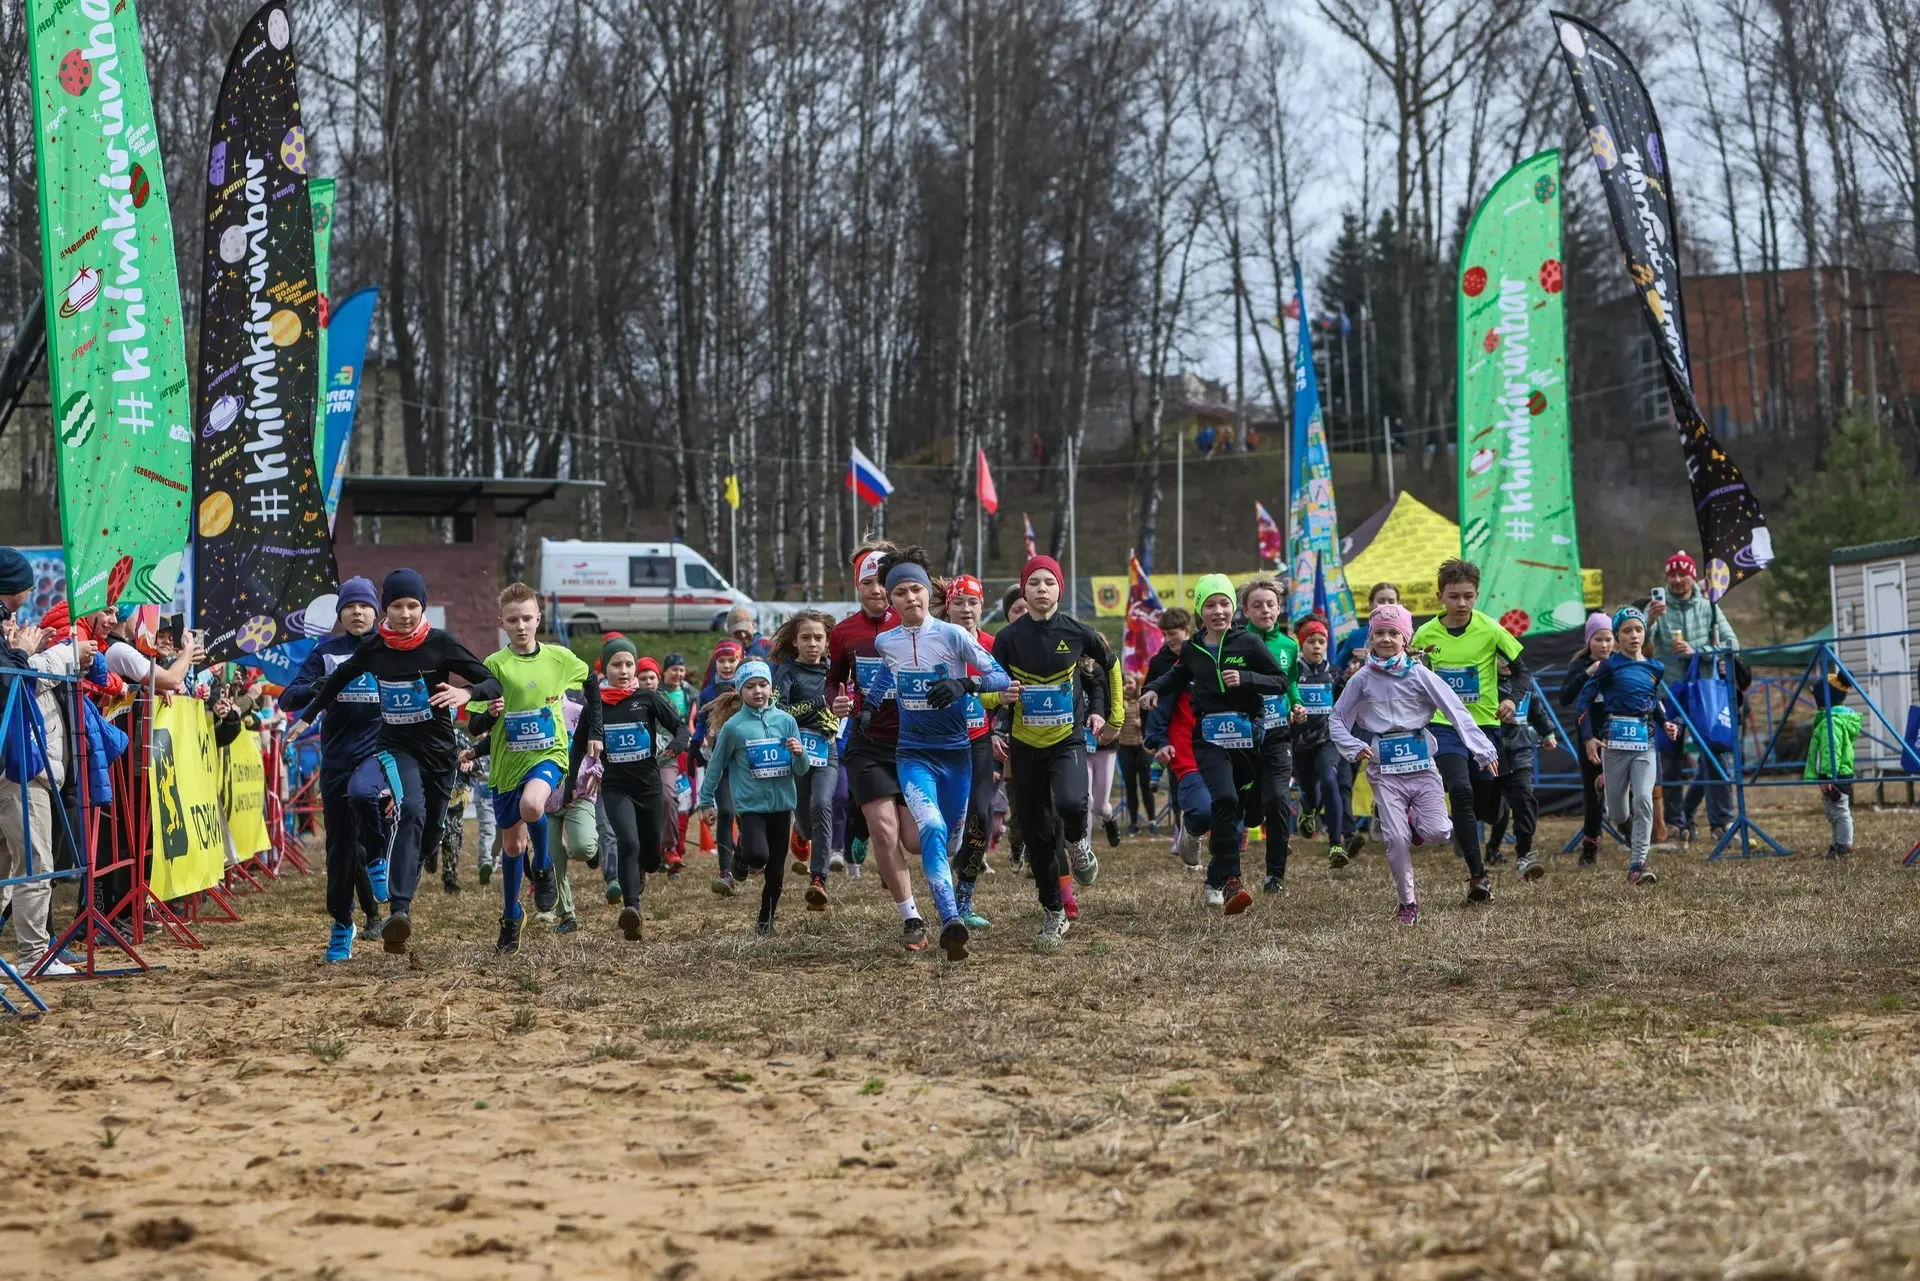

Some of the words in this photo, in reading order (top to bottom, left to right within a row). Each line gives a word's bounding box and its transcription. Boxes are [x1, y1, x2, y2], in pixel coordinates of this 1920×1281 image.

[1224, 656, 1244, 664] FILA
[357, 674, 367, 687] 2
[1449, 676, 1464, 690] 30
[392, 693, 413, 708] 12
[1043, 696, 1053, 709] 4
[1309, 692, 1323, 702] 31
[520, 721, 540, 735] 58
[1217, 720, 1236, 733] 48
[1622, 725, 1637, 738] 18
[618, 733, 636, 747] 13
[802, 736, 817, 750] 19
[762, 749, 778, 762] 10
[1393, 742, 1413, 757] 51
